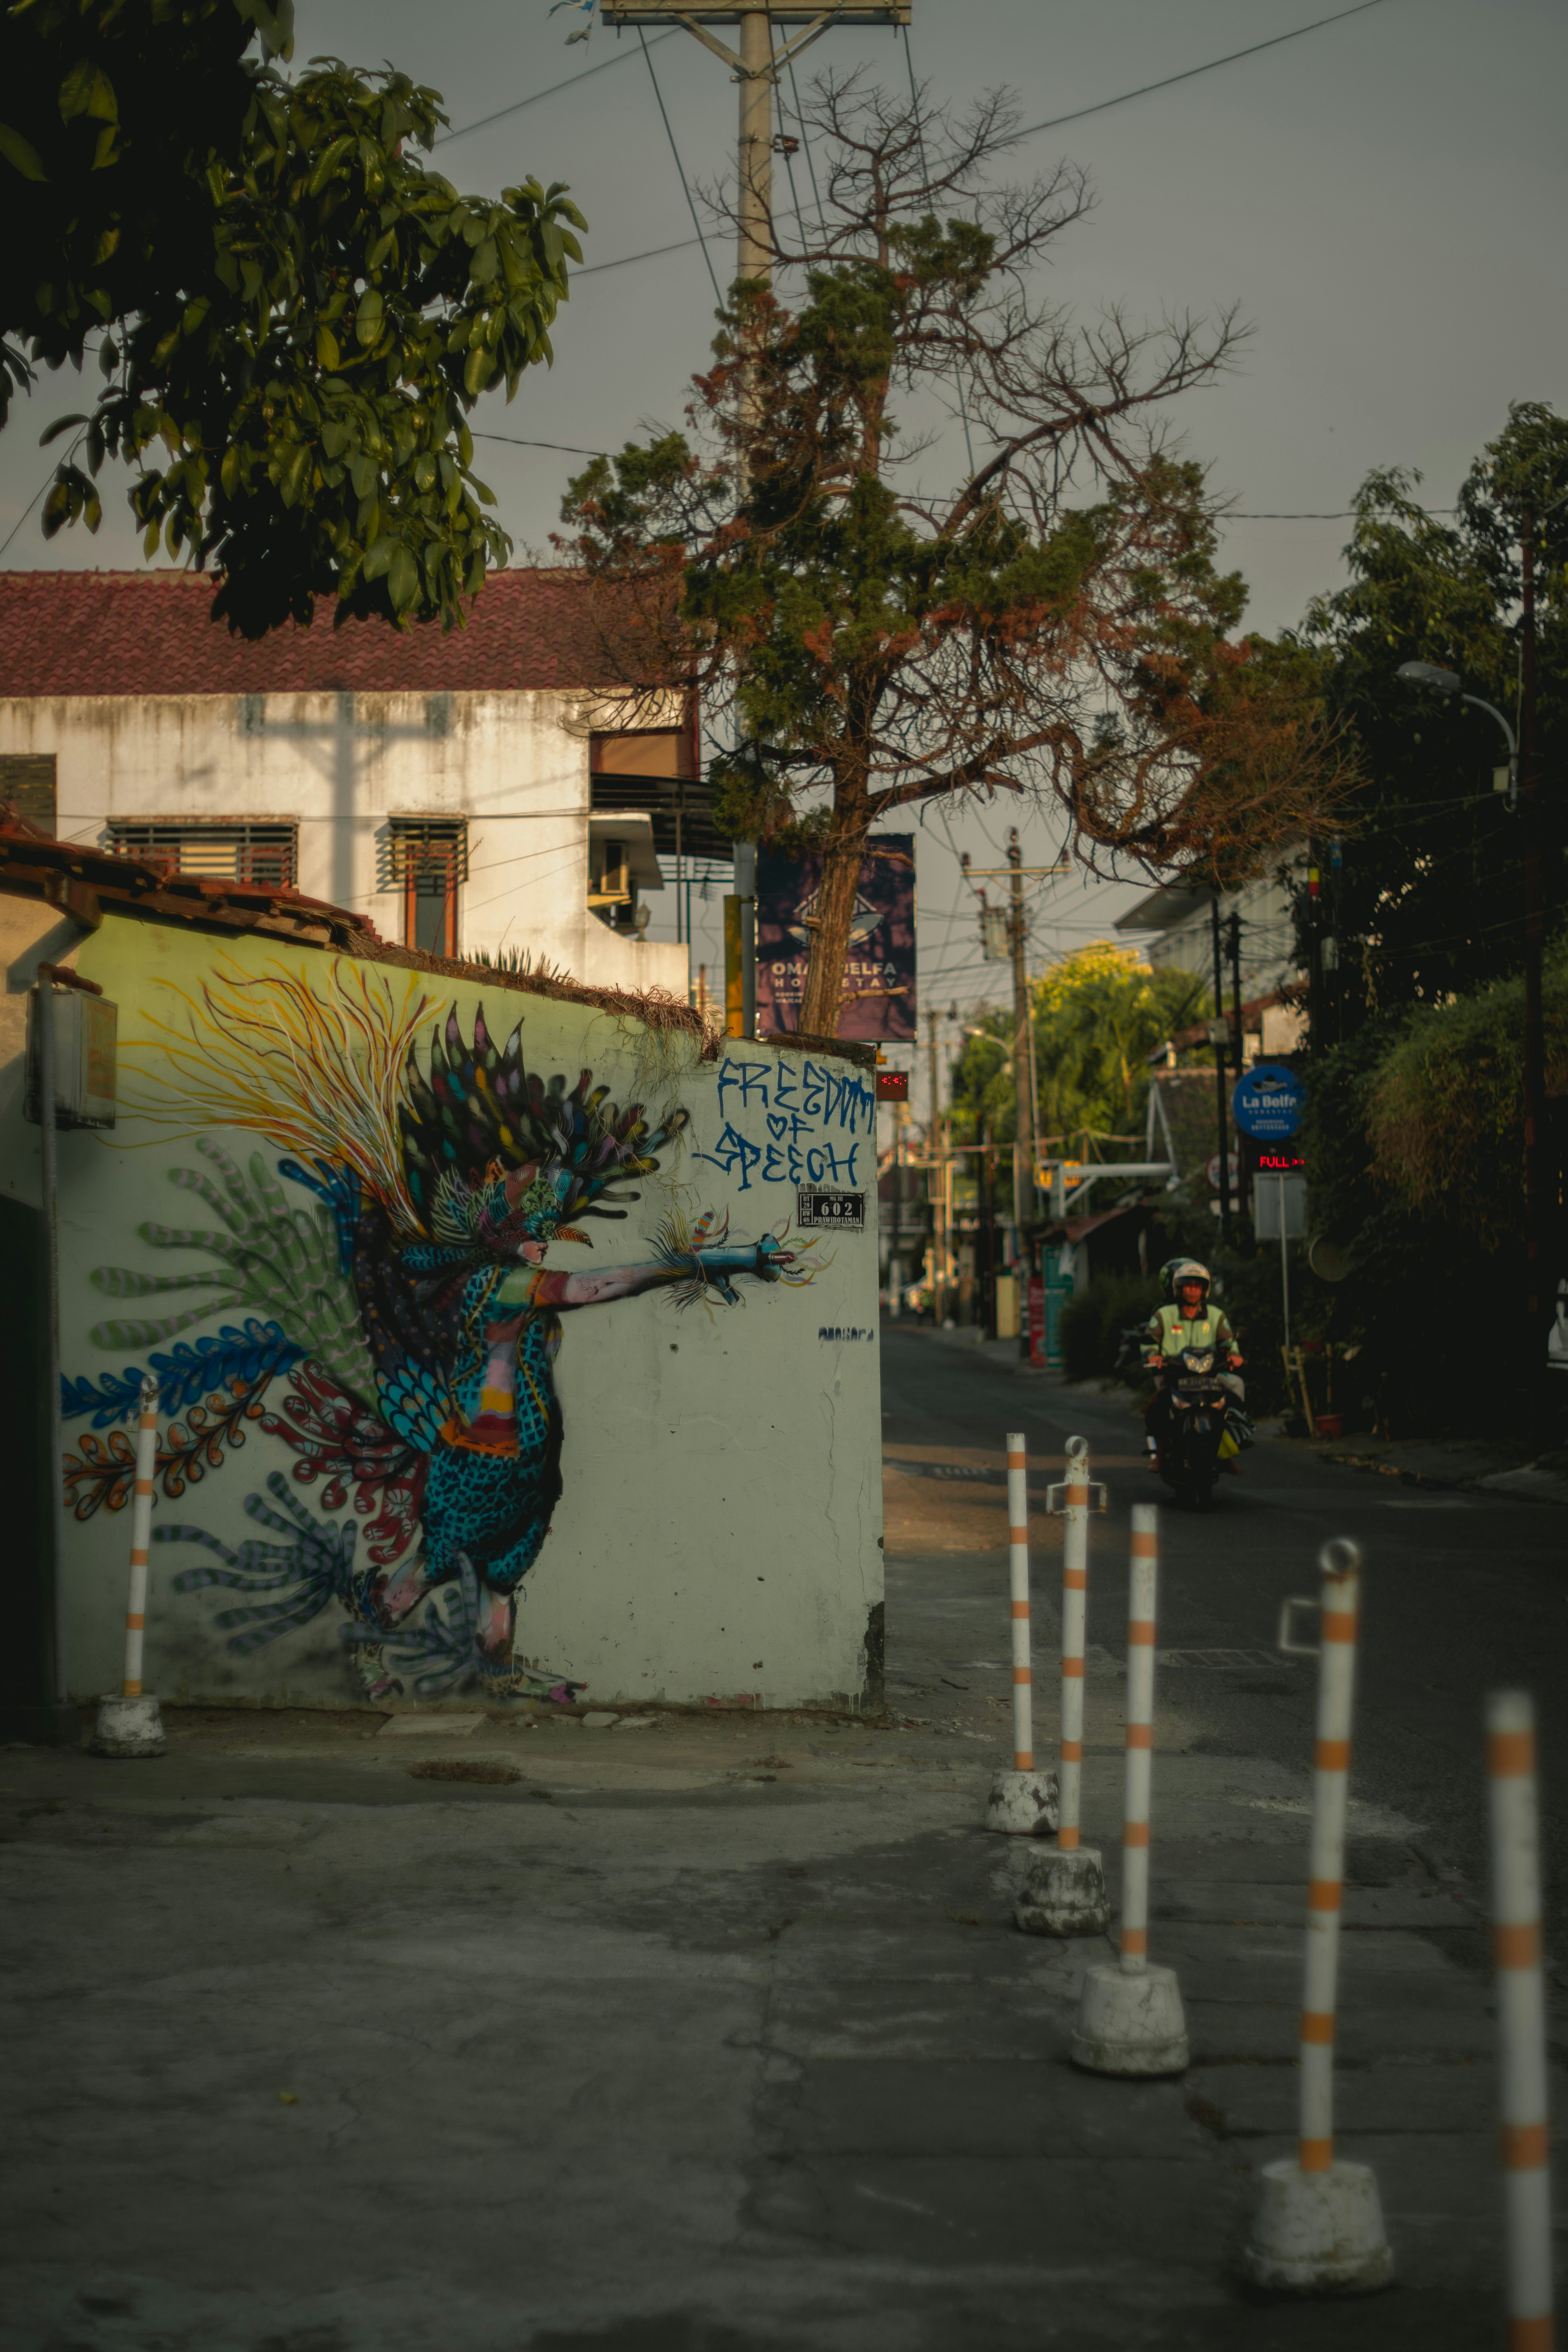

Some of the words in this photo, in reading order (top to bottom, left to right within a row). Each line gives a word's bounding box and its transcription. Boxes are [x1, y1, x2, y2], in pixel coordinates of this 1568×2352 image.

[774, 978, 895, 987] HOSTAY
[717, 1058, 874, 1134] FREEDOM
[1243, 1095, 1260, 1108] La
[692, 1122, 859, 1192] SPEECH
[1260, 1156, 1289, 1167] FULL
[821, 1202, 852, 1216] 602
